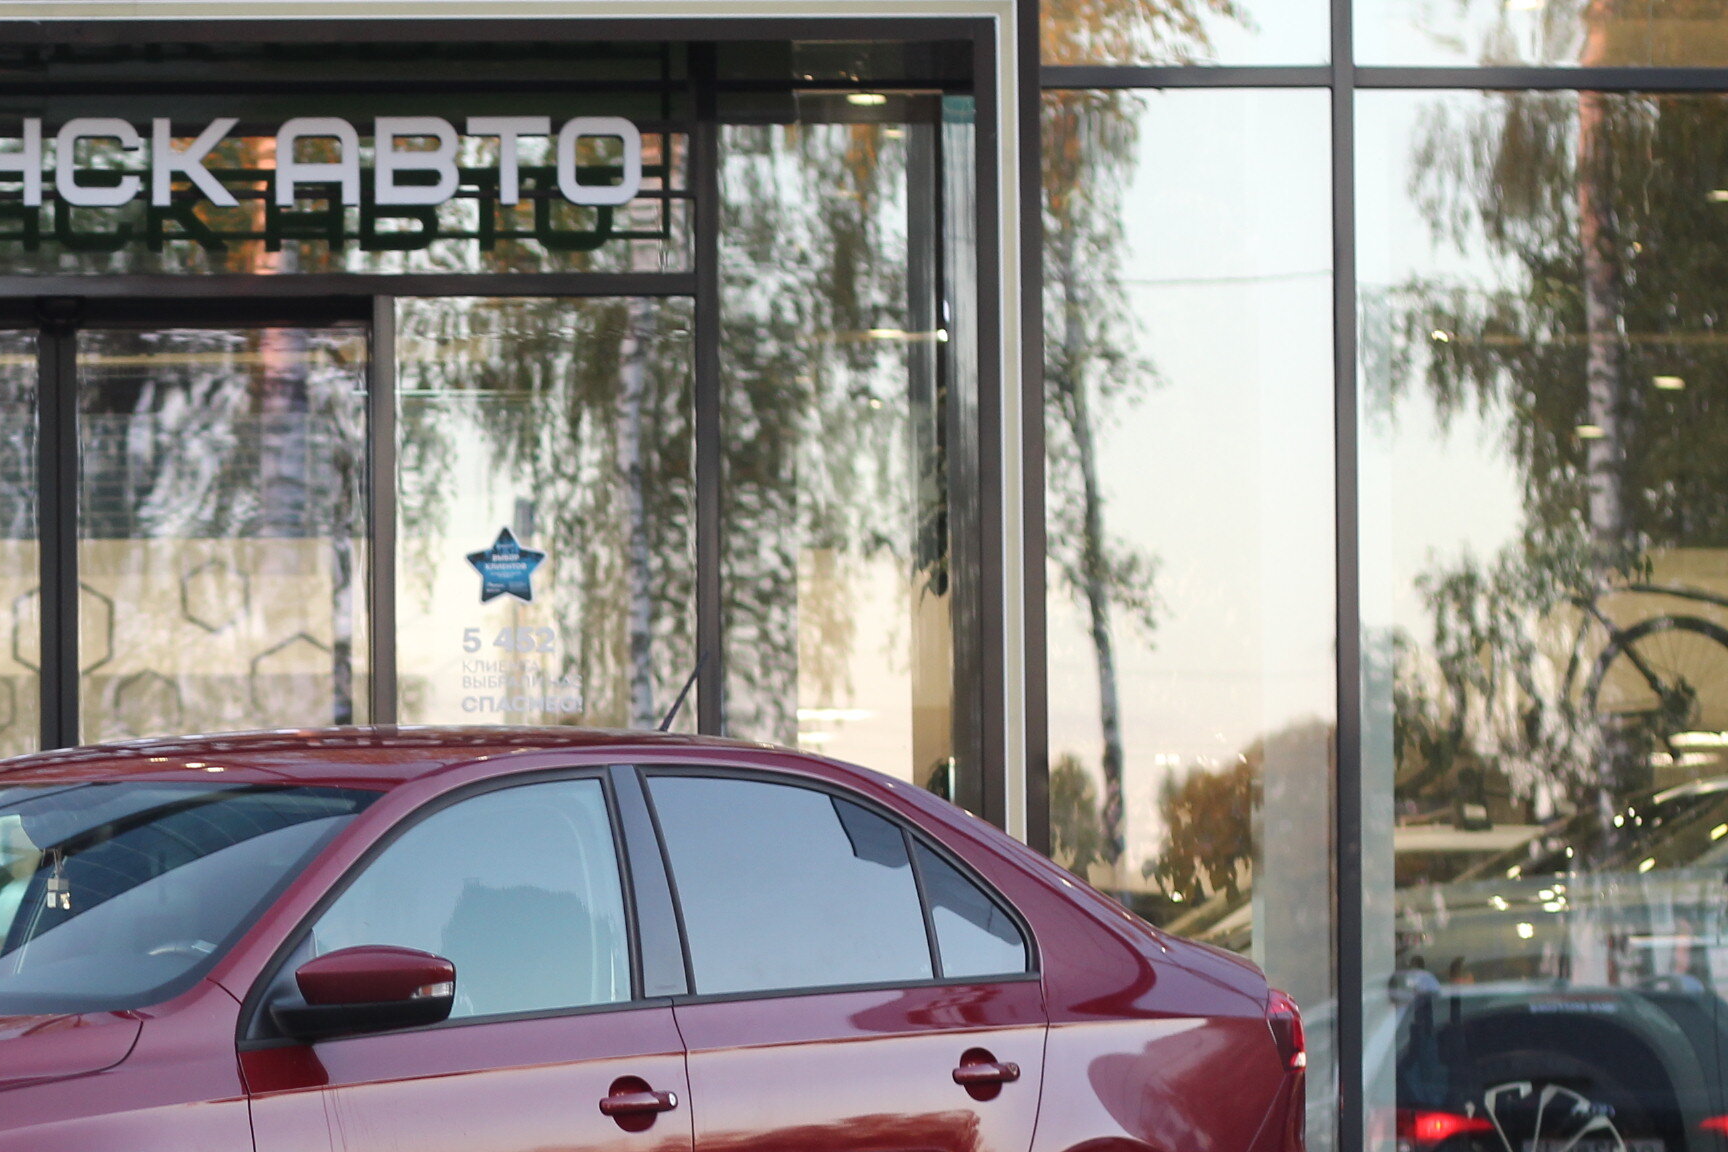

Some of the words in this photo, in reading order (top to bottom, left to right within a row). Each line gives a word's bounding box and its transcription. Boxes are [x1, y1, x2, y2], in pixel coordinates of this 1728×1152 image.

[273, 116, 643, 207] АВТО
[462, 627, 482, 653] 5
[492, 627, 556, 653] 452
